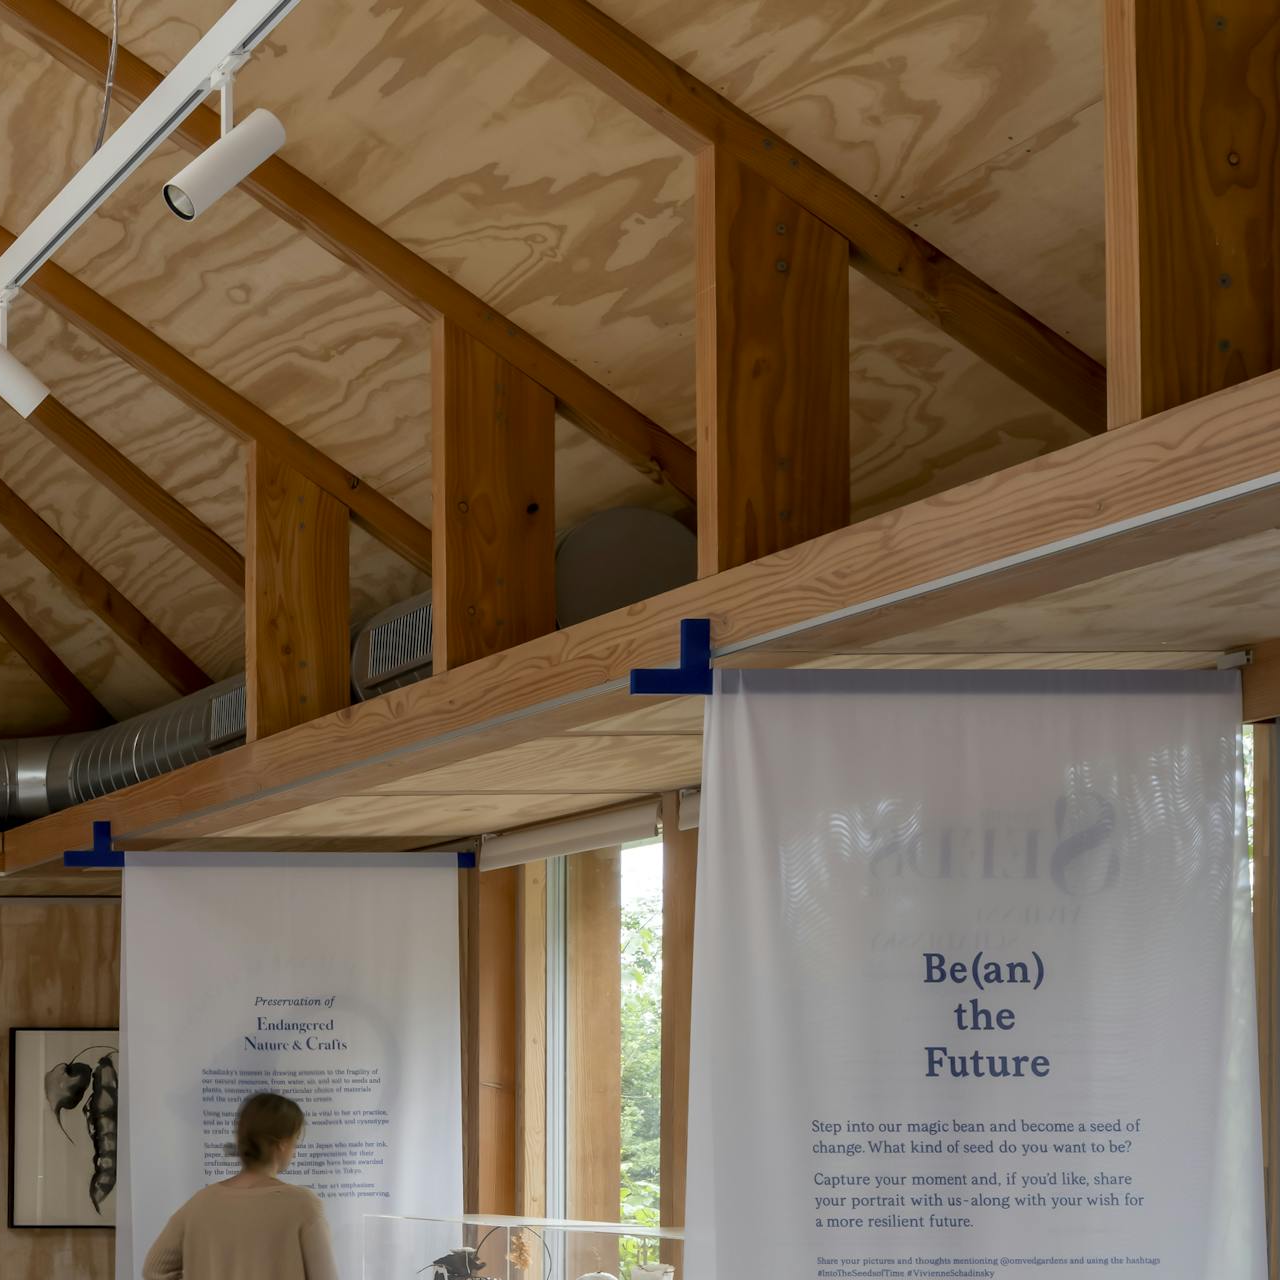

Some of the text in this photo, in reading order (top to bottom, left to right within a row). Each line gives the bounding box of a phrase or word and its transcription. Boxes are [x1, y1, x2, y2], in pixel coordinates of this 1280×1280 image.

[923, 951, 1044, 990] Be(an)
[254, 996, 336, 1008] Preservation of
[953, 998, 1015, 1030] the
[257, 1017, 334, 1033] Endangered
[244, 1036, 347, 1050] Nature & Crafts
[924, 1047, 1050, 1077] Future
[812, 1119, 1141, 1135] Step into our magic bean and become a seed of
[812, 1140, 1132, 1156] change. What kind of seed do you want to be?
[814, 1172, 1132, 1188] Capture your moment and, if you'd like, share
[815, 1197, 846, 1209] your
[851, 1194, 905, 1209] portrait
[910, 1193, 943, 1206] with
[1014, 1193, 1046, 1206] with
[1051, 1196, 1083, 1209] your
[1087, 1193, 1119, 1206] wish
[1124, 1193, 1144, 1206] for
[815, 1214, 974, 1227] a more resilient future.
[817, 1257, 838, 1265] Share
[863, 1257, 895, 1266] pictures
[897, 1257, 912, 1265] and
[915, 1257, 951, 1266] thoughts
[953, 1257, 999, 1266] mentioning
[1000, 1257, 1067, 1266] @omvedgardens
[1070, 1257, 1084, 1265] and
[1086, 1257, 1108, 1266] using
[1110, 1257, 1123, 1265] the
[1126, 1257, 1160, 1266] hashtags
